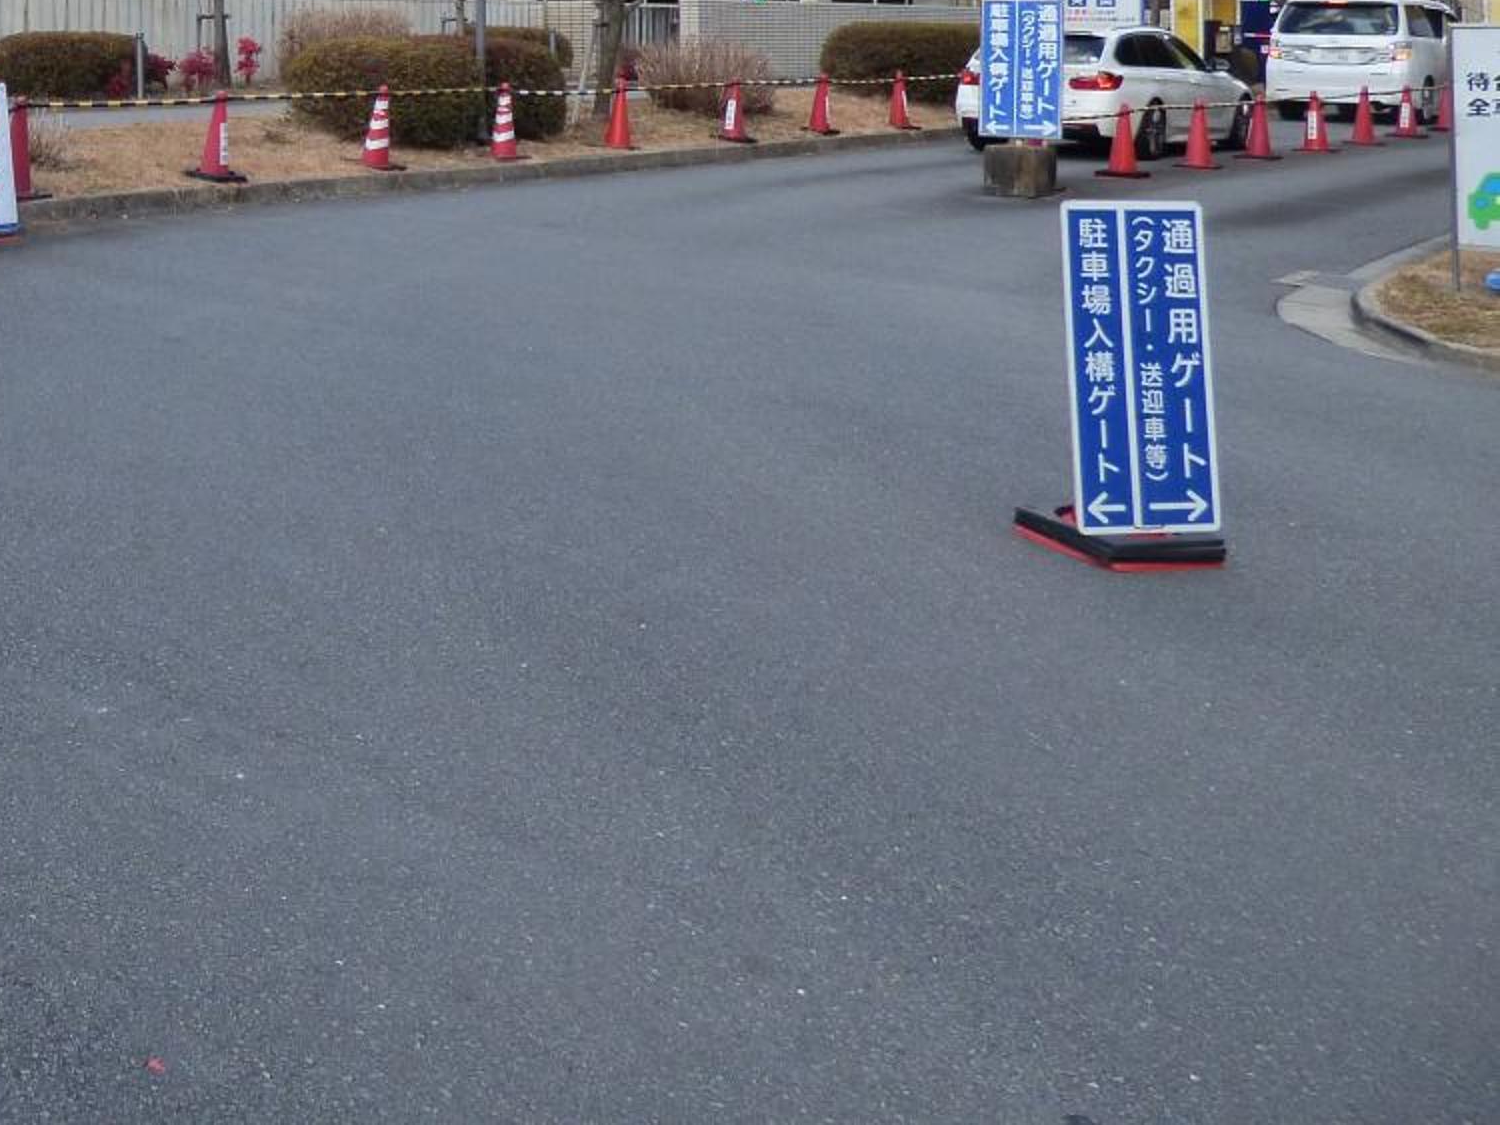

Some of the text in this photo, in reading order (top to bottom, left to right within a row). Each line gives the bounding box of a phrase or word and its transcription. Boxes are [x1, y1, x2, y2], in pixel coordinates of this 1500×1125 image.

[1466, 72, 1500, 92] 待
[1078, 218, 1120, 483] 駐車場入構ゲート
[1131, 216, 1169, 482] (タクシー・送迎車等)
[1160, 218, 1208, 479] 通過用ゲート
